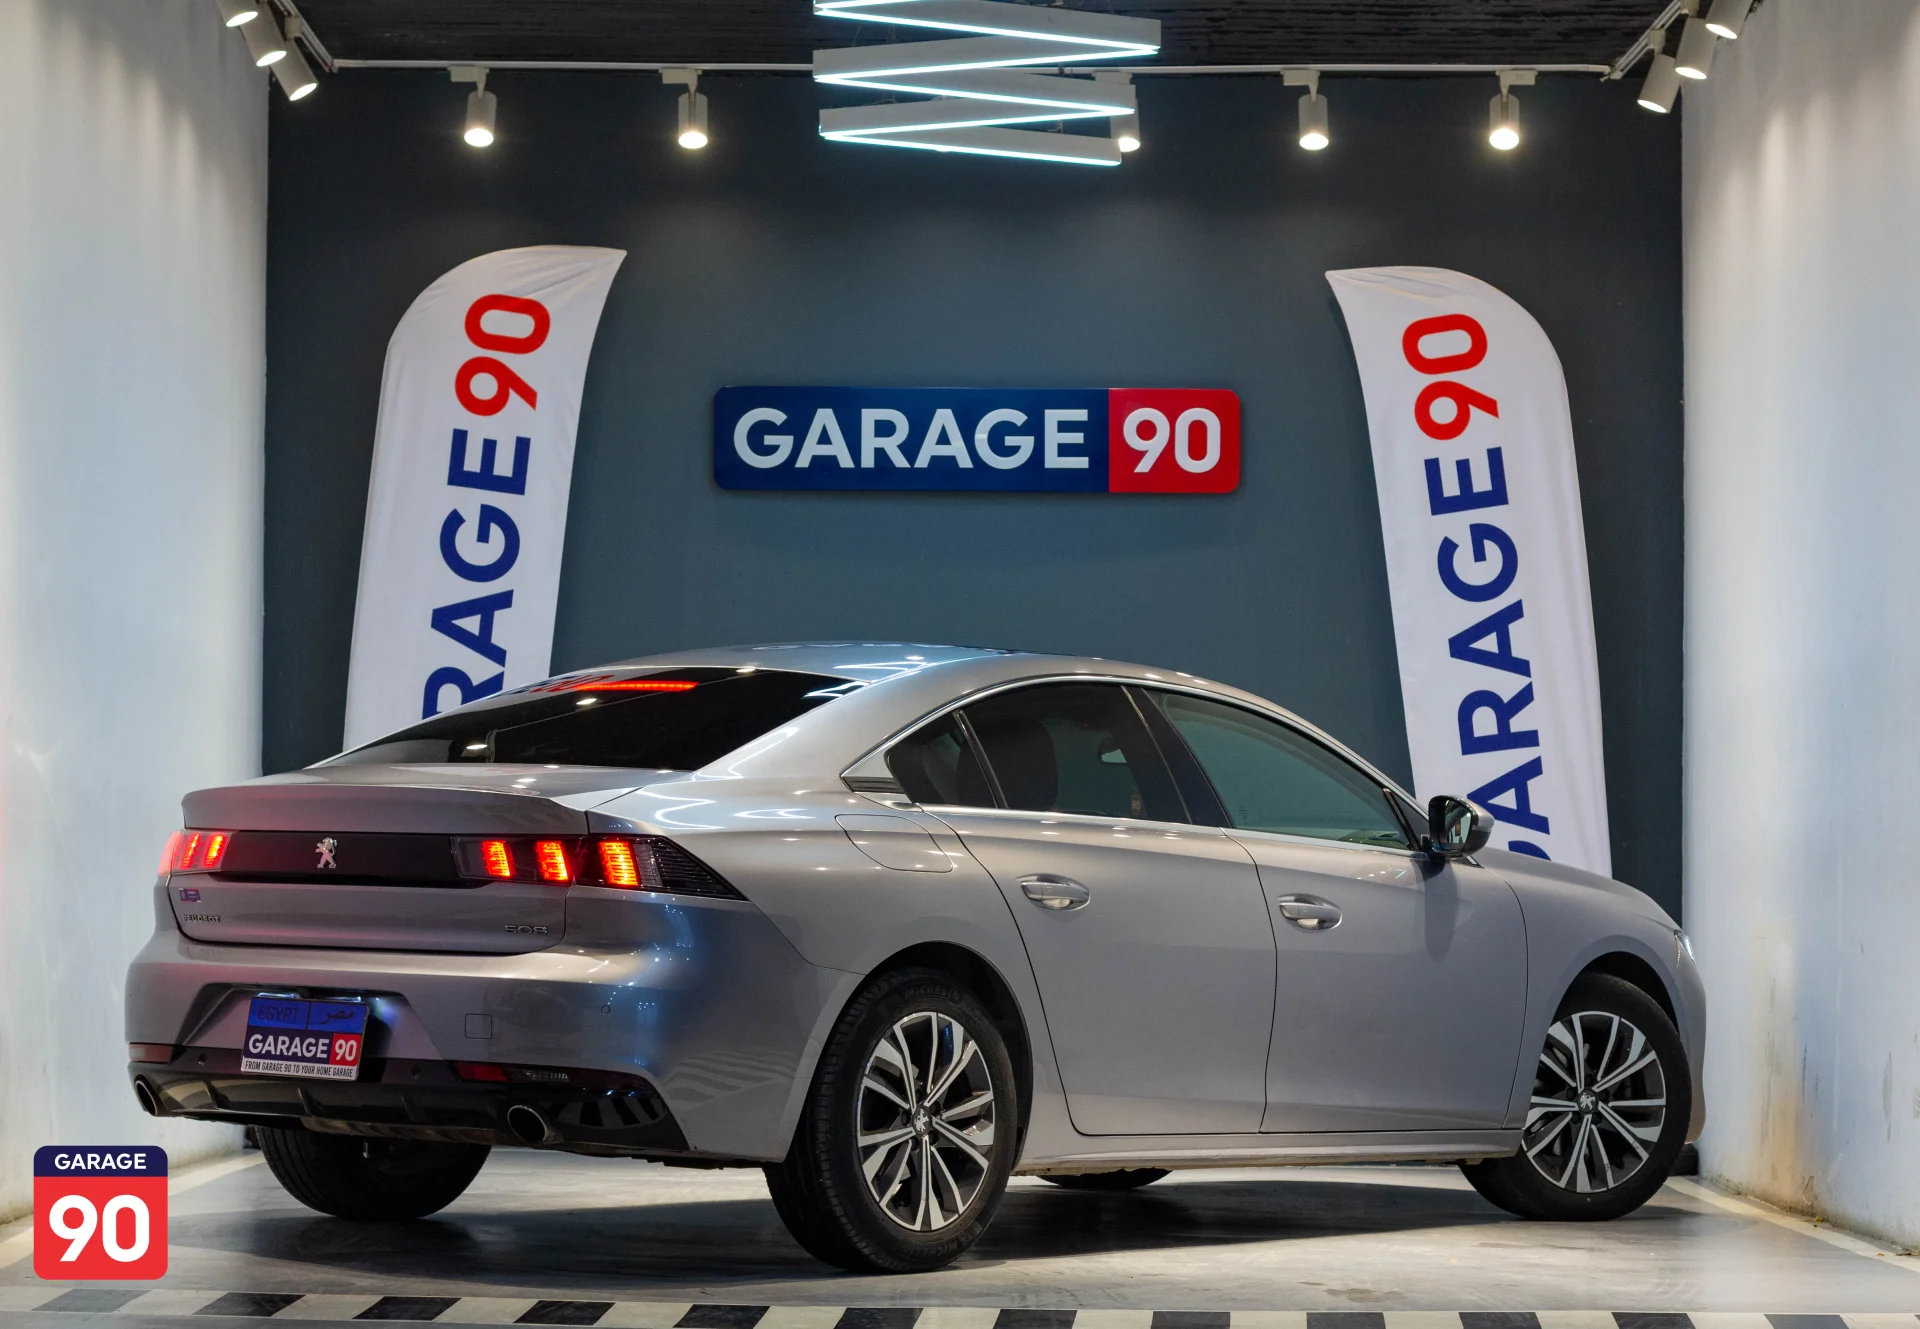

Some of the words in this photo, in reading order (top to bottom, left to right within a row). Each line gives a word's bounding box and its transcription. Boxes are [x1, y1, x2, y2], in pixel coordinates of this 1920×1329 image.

[454, 293, 551, 417] 90
[1402, 313, 1500, 441] 90
[733, 407, 1089, 469] GARAGE
[1122, 407, 1221, 474] 90
[422, 428, 531, 720] RAGE
[1424, 446, 1552, 861] ARAGE
[181, 914, 220, 923] PEUGEOT
[504, 924, 547, 935] 508
[257, 1004, 300, 1024] EGYPT
[321, 1009, 355, 1025] مصر
[248, 1034, 330, 1059] GARAGE
[334, 1038, 357, 1062] 90
[244, 1060, 260, 1070] FROM
[261, 1062, 283, 1072] GARAGE
[284, 1063, 292, 1073] 90
[293, 1064, 300, 1074] TO
[301, 1065, 316, 1075] YOUR
[316, 1066, 332, 1076] HOME
[332, 1067, 353, 1078] GARAGE
